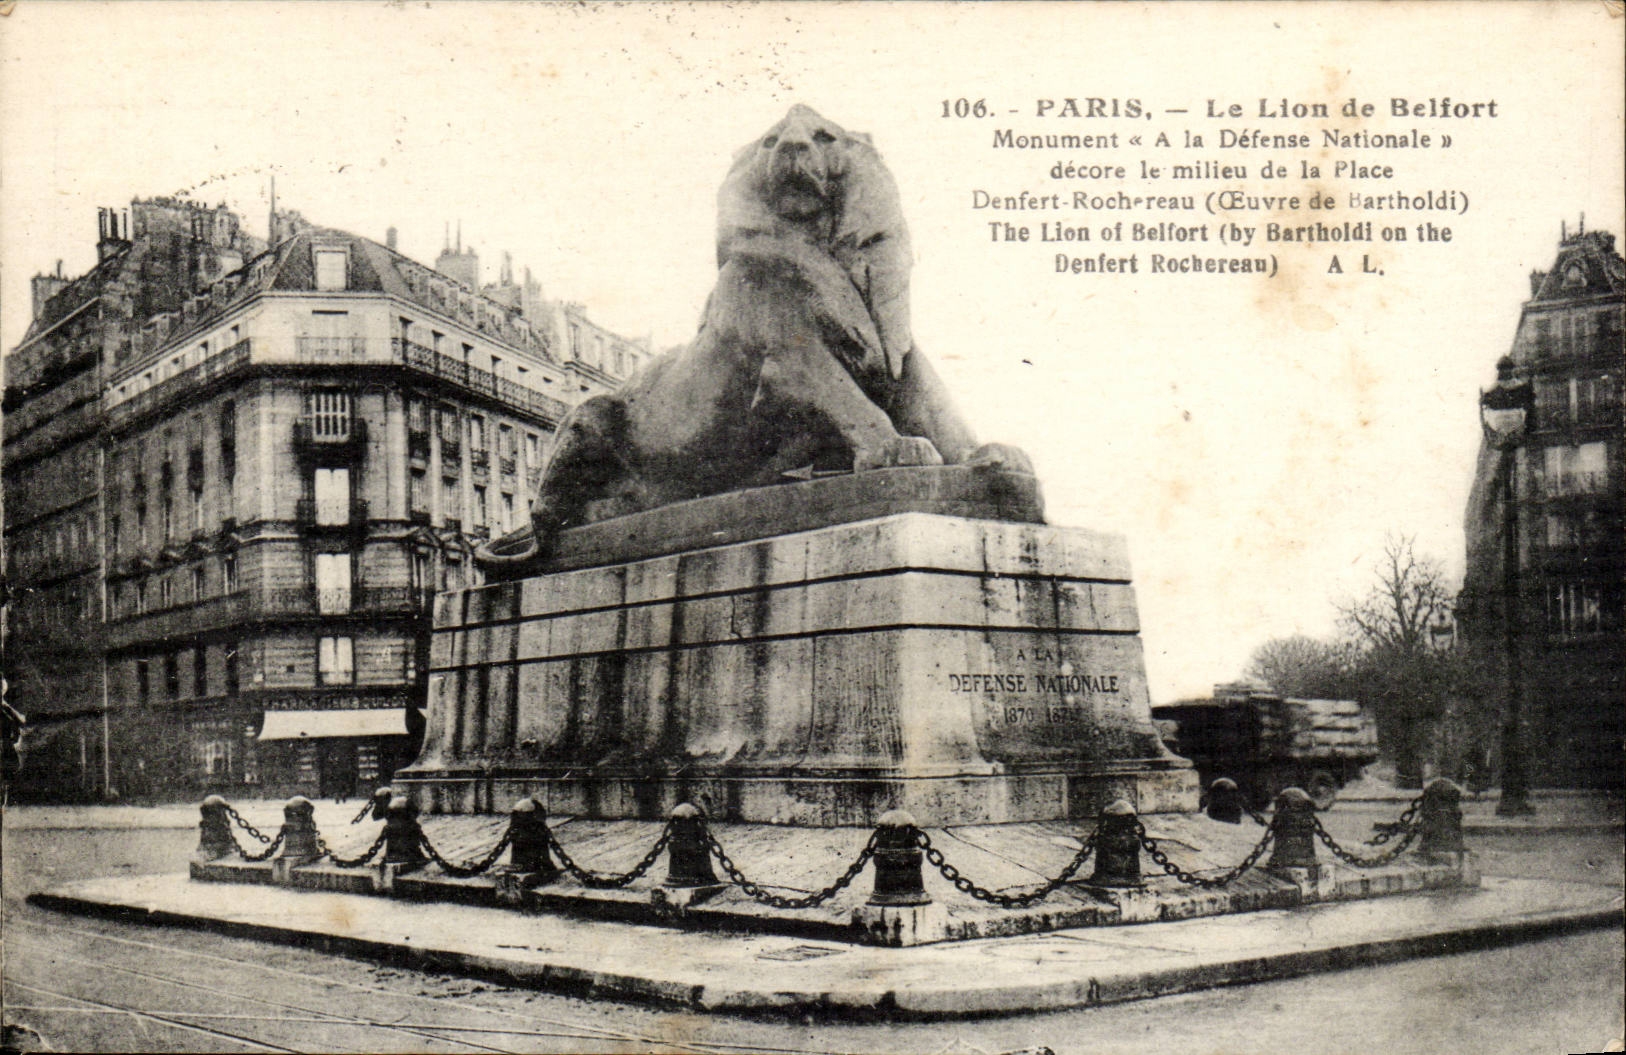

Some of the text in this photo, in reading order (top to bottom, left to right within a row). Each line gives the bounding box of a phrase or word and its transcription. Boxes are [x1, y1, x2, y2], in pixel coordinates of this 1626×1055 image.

[949, 673, 1121, 695] DEFENSE NATIONALE
[1003, 706, 1035, 725] 1870
